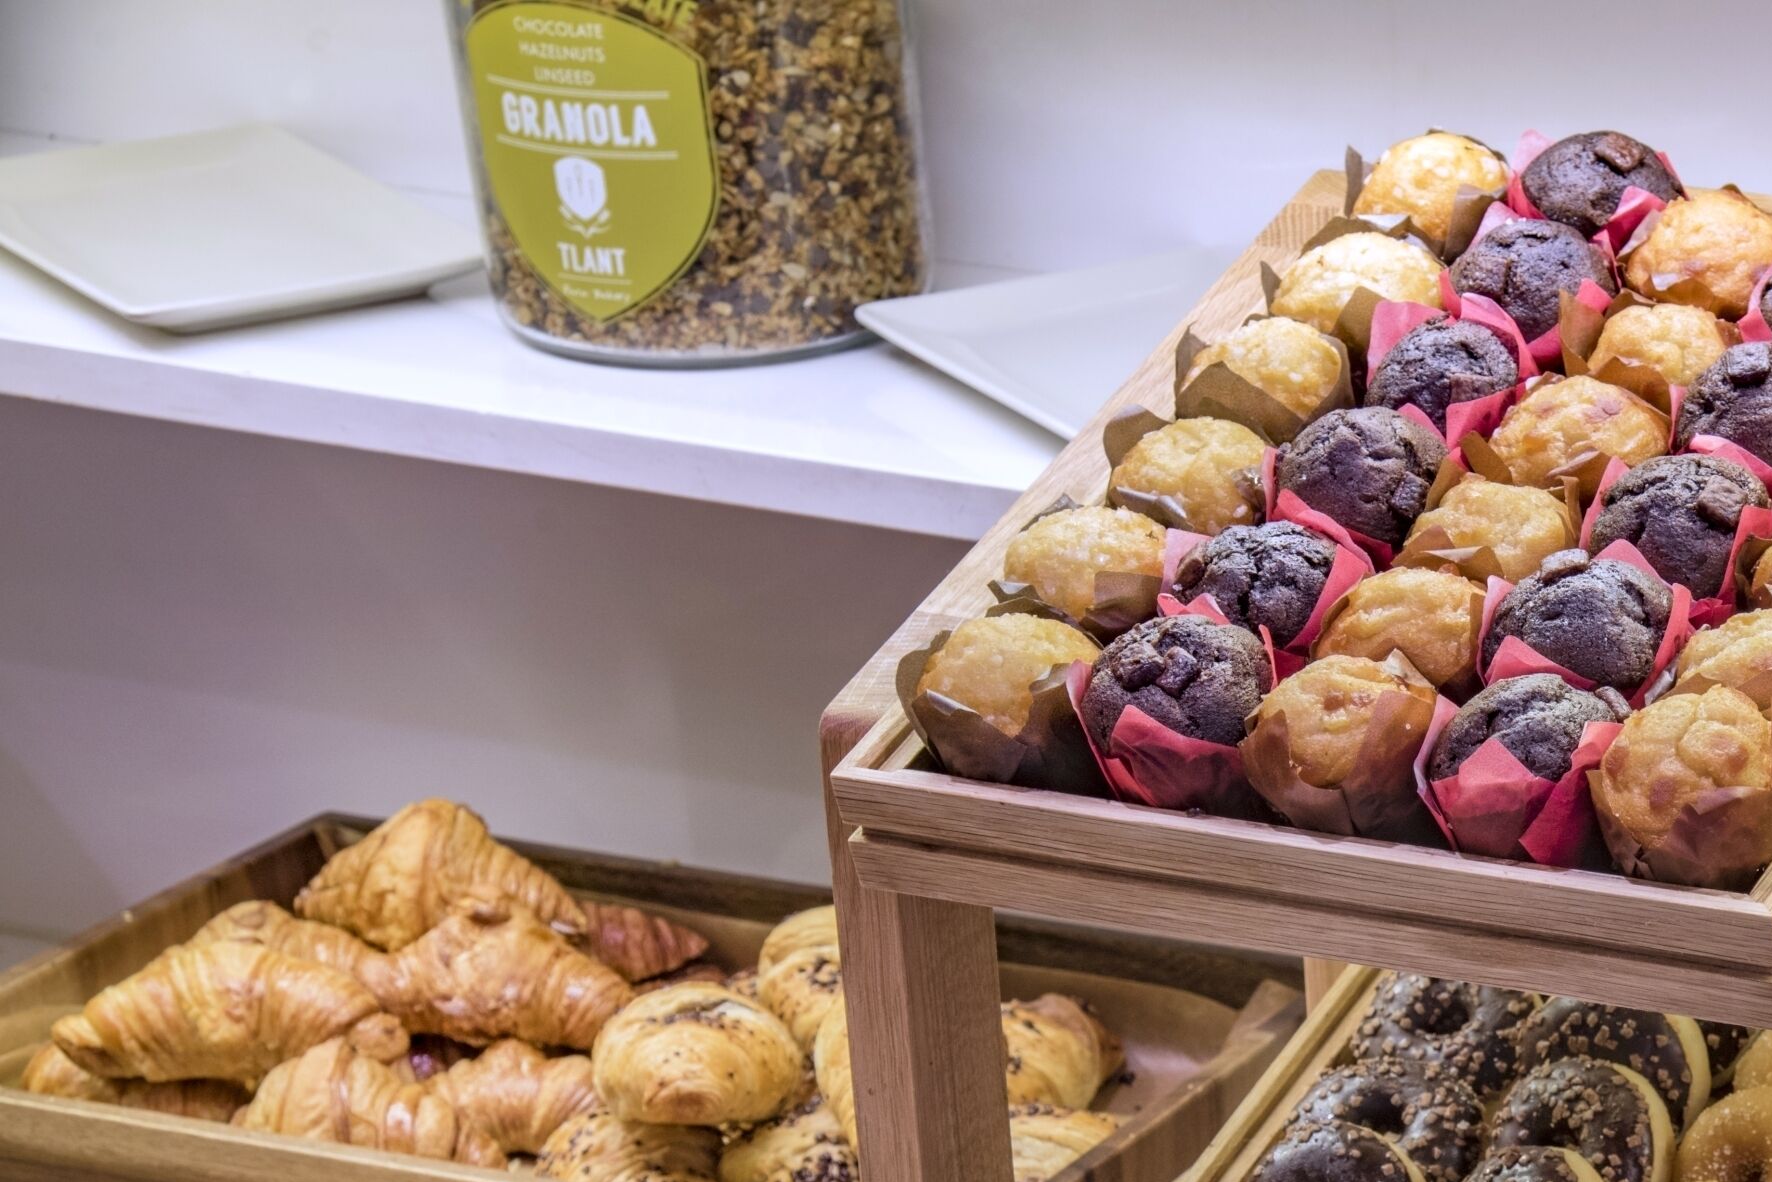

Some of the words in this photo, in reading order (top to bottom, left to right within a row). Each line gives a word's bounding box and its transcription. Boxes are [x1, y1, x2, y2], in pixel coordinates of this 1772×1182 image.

[512, 16, 605, 40] CHOCOLATE
[518, 40, 606, 64] HAZELNUTS
[501, 91, 658, 148] GRANOLA
[556, 241, 627, 277] TLANT
